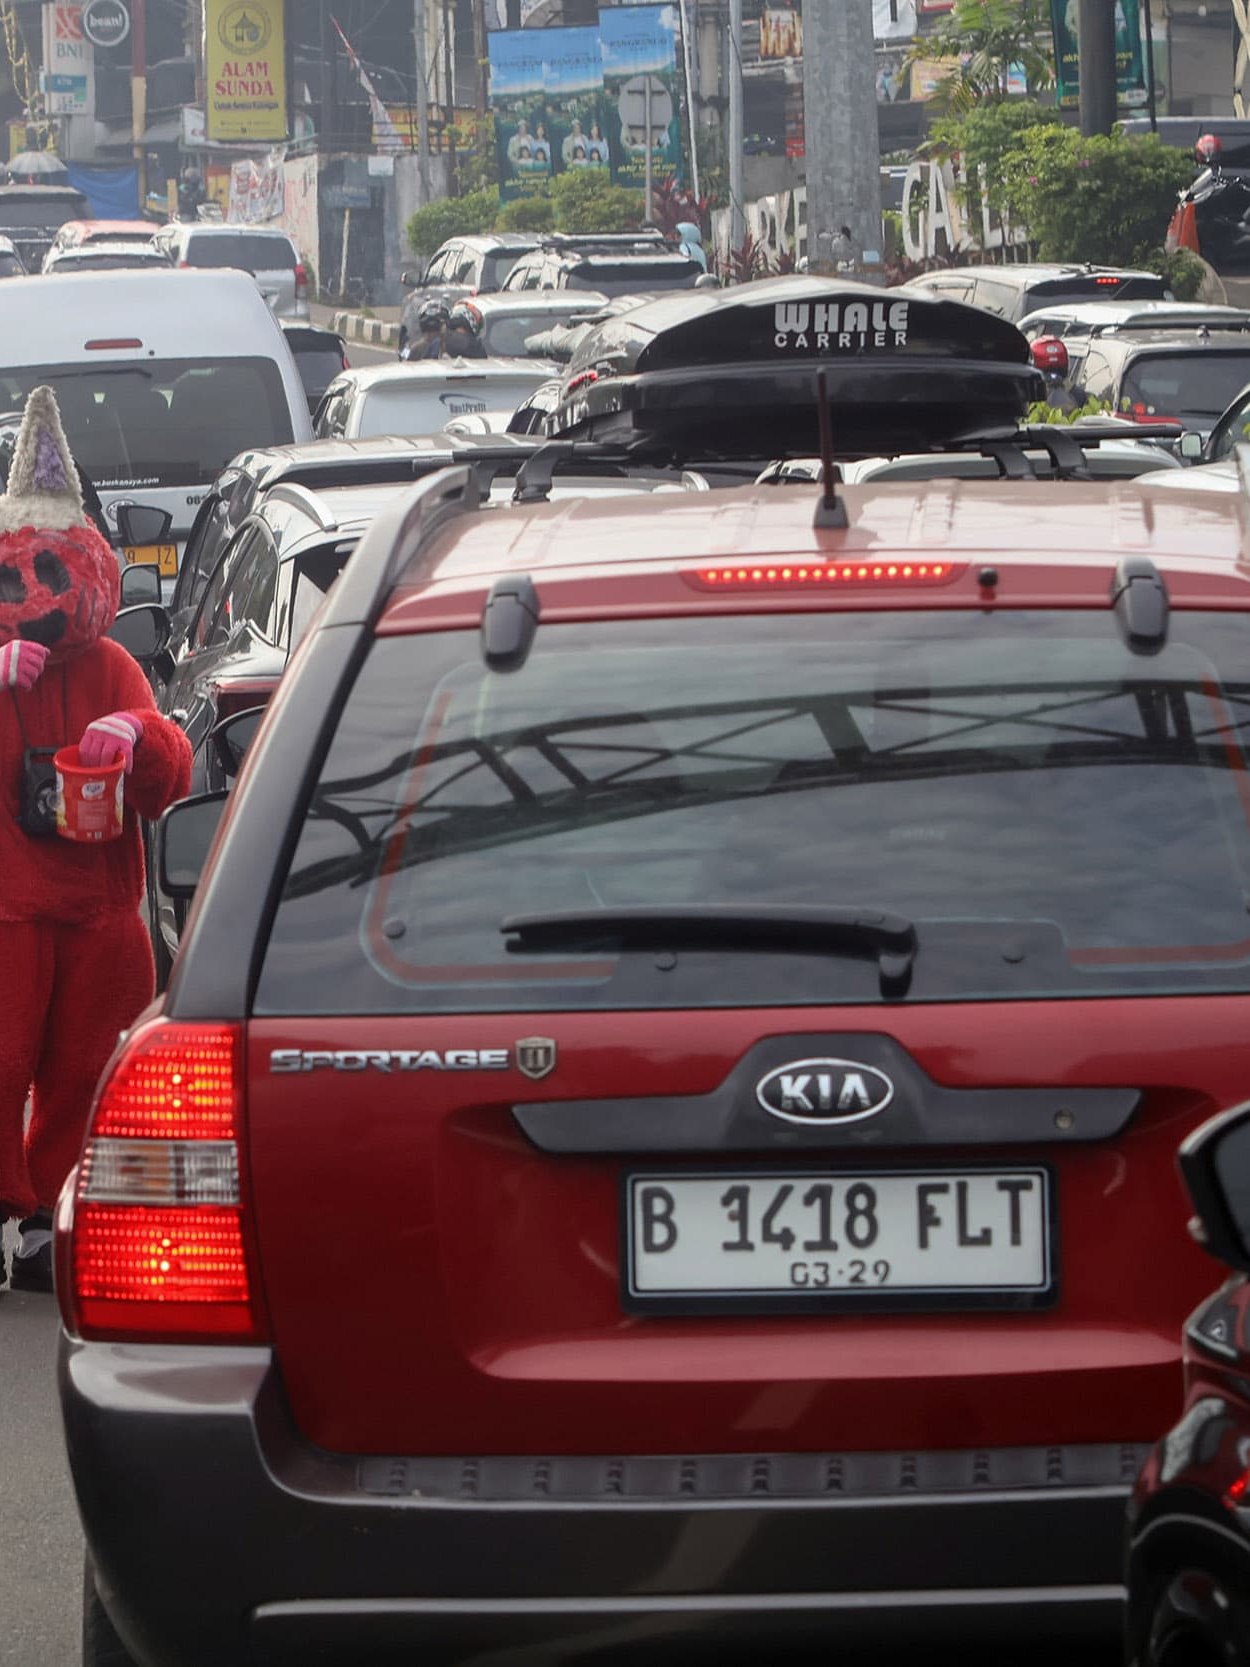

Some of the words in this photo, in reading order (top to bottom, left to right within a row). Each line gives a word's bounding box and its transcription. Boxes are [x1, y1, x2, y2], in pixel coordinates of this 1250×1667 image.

[56, 43, 83, 58] BNI
[222, 62, 268, 77] ALAM
[215, 80, 274, 96] SUNDA
[774, 301, 909, 333] WHALE
[774, 331, 907, 348] CARRIER
[269, 1048, 509, 1073] SPORTAGE
[780, 1075, 873, 1110] KIA
[641, 1187, 678, 1254] B
[720, 1182, 879, 1252] 1418
[917, 1180, 1034, 1250] FLT
